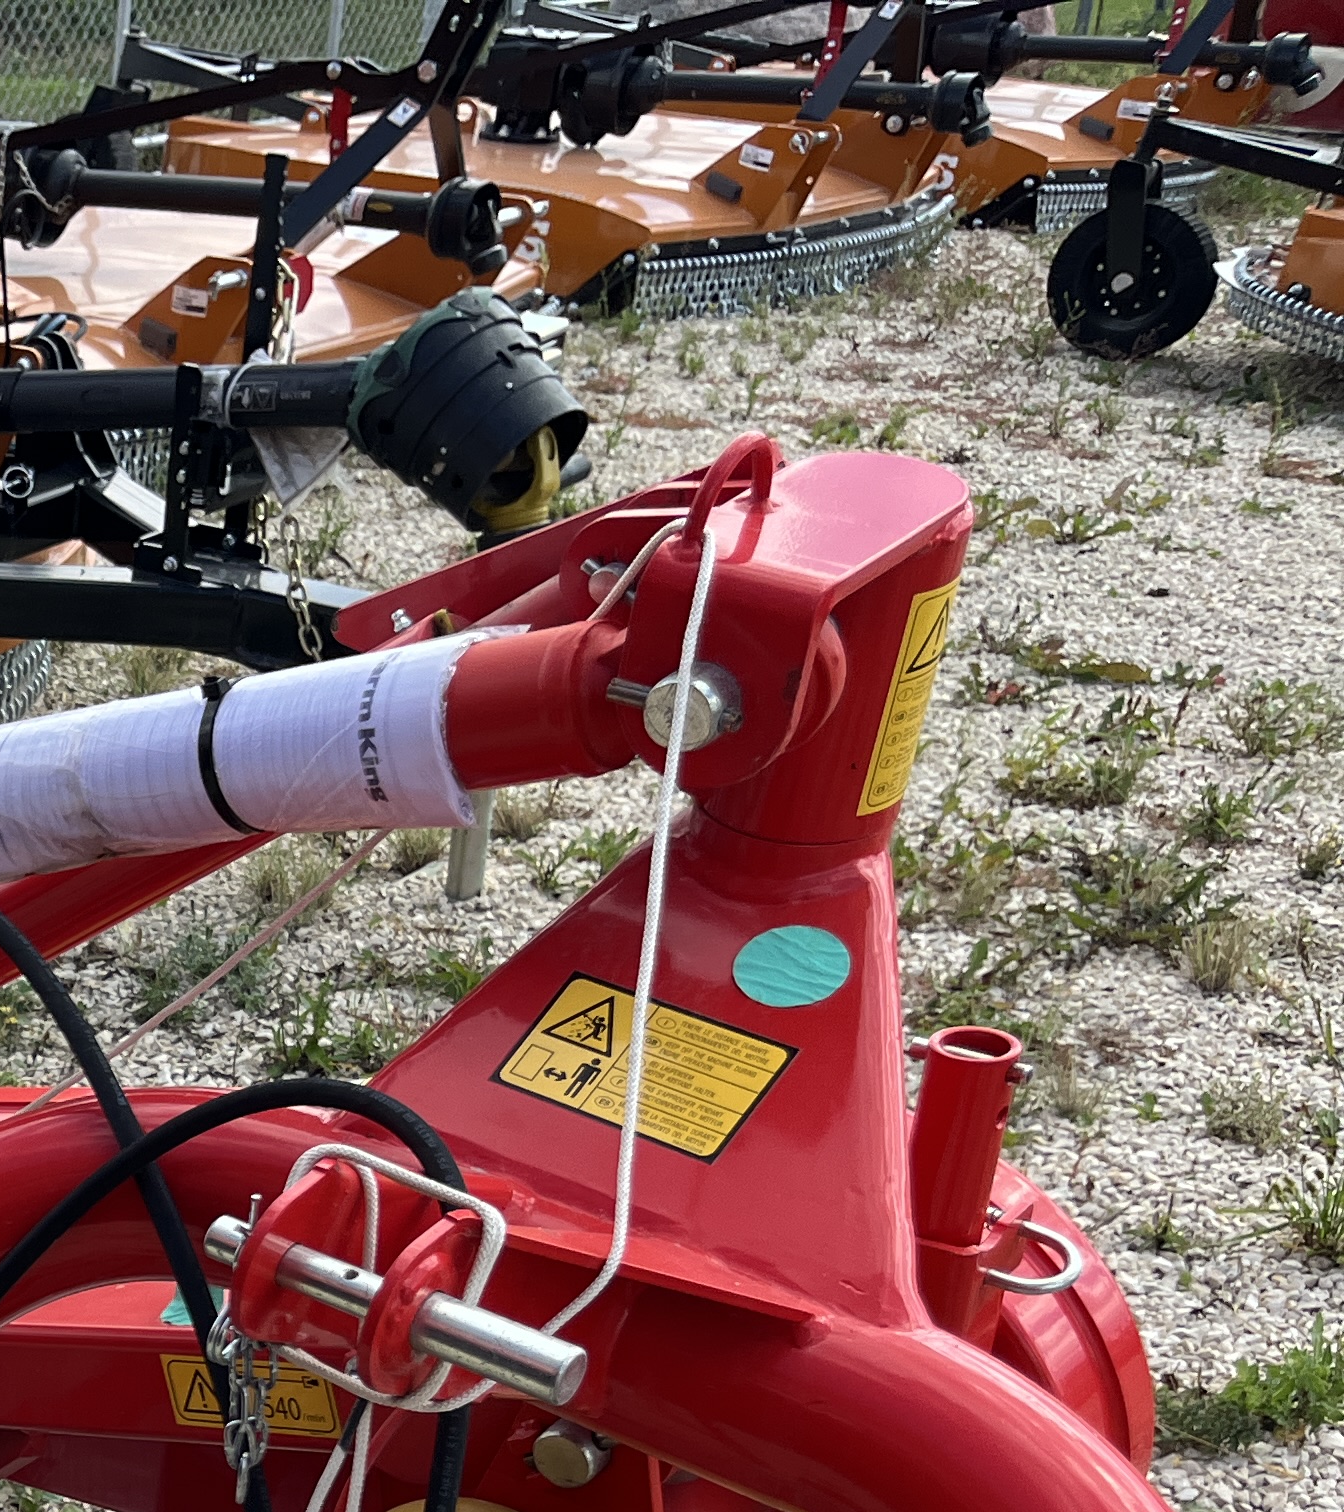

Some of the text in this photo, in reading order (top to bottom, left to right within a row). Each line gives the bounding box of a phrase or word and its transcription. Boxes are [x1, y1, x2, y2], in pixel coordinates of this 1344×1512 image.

[358, 727, 389, 803] King
[664, 1041, 680, 1050] KEEP
[680, 1046, 692, 1054] OFF
[694, 1051, 705, 1059] THE
[263, 1395, 301, 1420] 540
